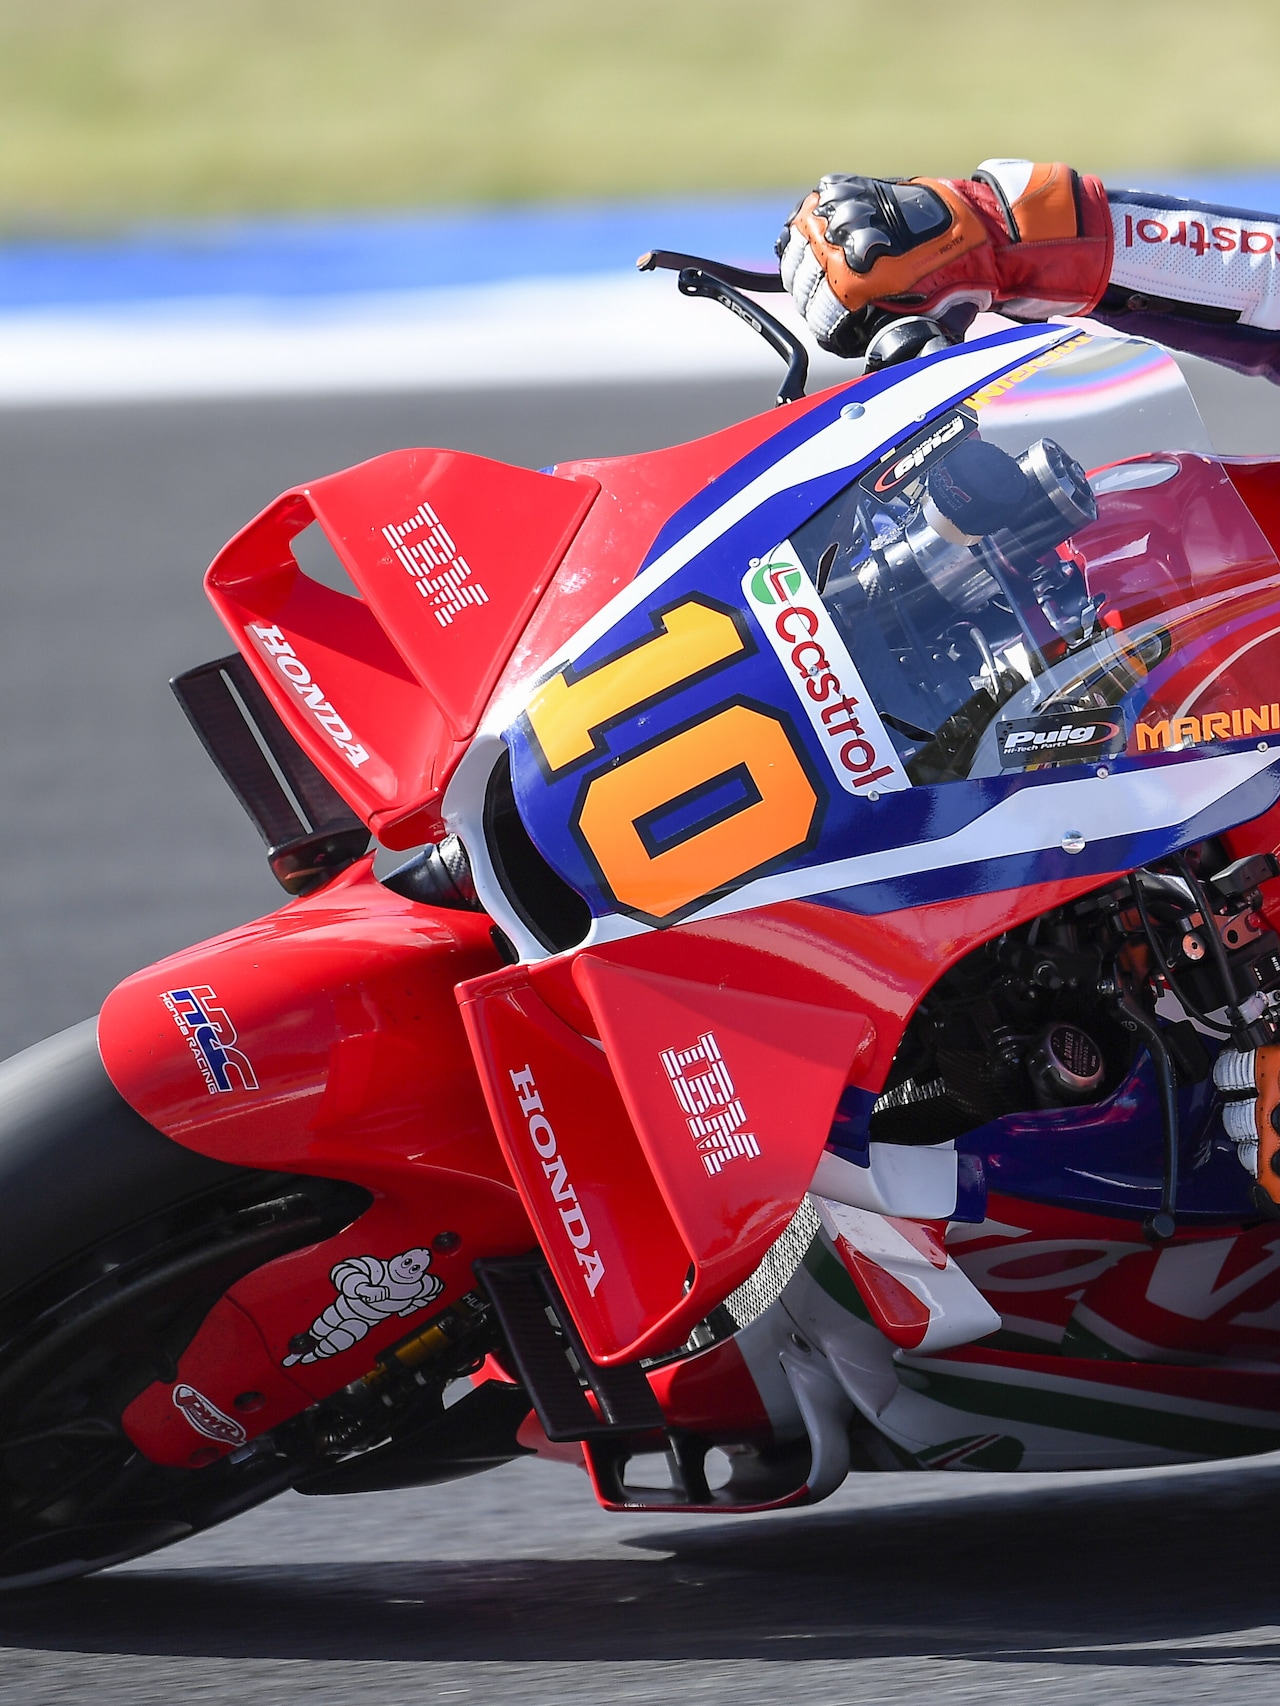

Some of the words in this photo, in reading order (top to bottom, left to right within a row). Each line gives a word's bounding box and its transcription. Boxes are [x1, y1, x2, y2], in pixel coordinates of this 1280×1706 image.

[962, 334, 1093, 411] MARINI
[893, 418, 965, 480] Puig
[381, 501, 490, 628] IBM
[251, 623, 371, 769] HONDA
[774, 605, 895, 790] Castrol
[1004, 724, 1097, 749] Puig
[1135, 702, 1280, 751] MARINI
[525, 594, 826, 924] 10
[1003, 744, 1039, 755] Hi-Tech
[1040, 740, 1067, 750] Parts
[185, 1036, 218, 1095] RACING
[659, 1030, 761, 1178] IBM
[508, 1062, 607, 1299] HONDA
